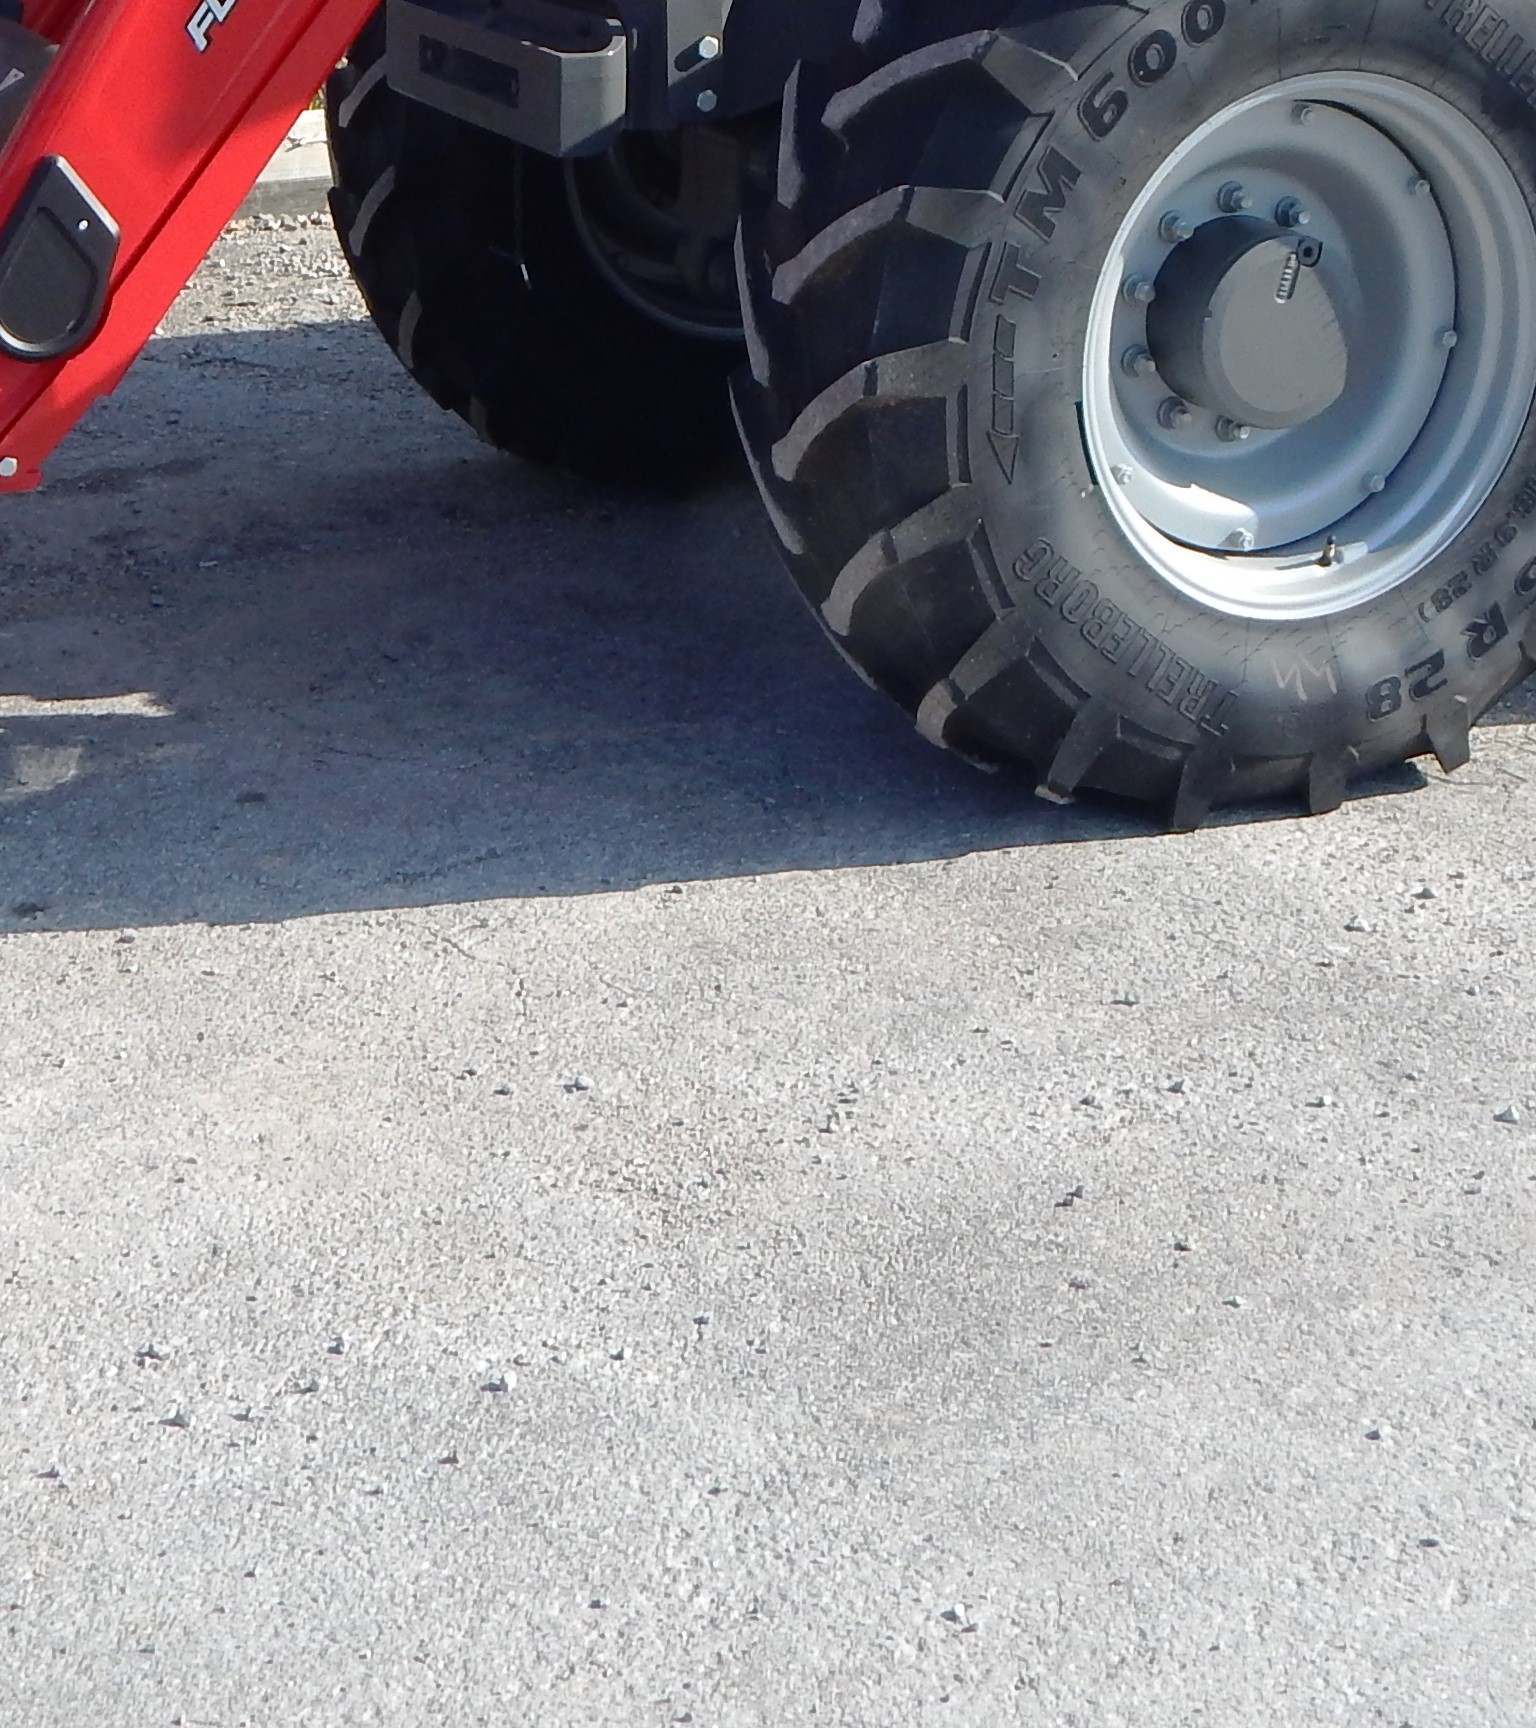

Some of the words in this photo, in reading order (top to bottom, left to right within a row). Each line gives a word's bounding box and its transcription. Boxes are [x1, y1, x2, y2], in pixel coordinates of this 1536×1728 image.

[988, 145, 1083, 306] TM
[1012, 536, 1240, 738] TRELLEBORG
[1366, 649, 1448, 725] 28
[1461, 601, 1511, 662] R
